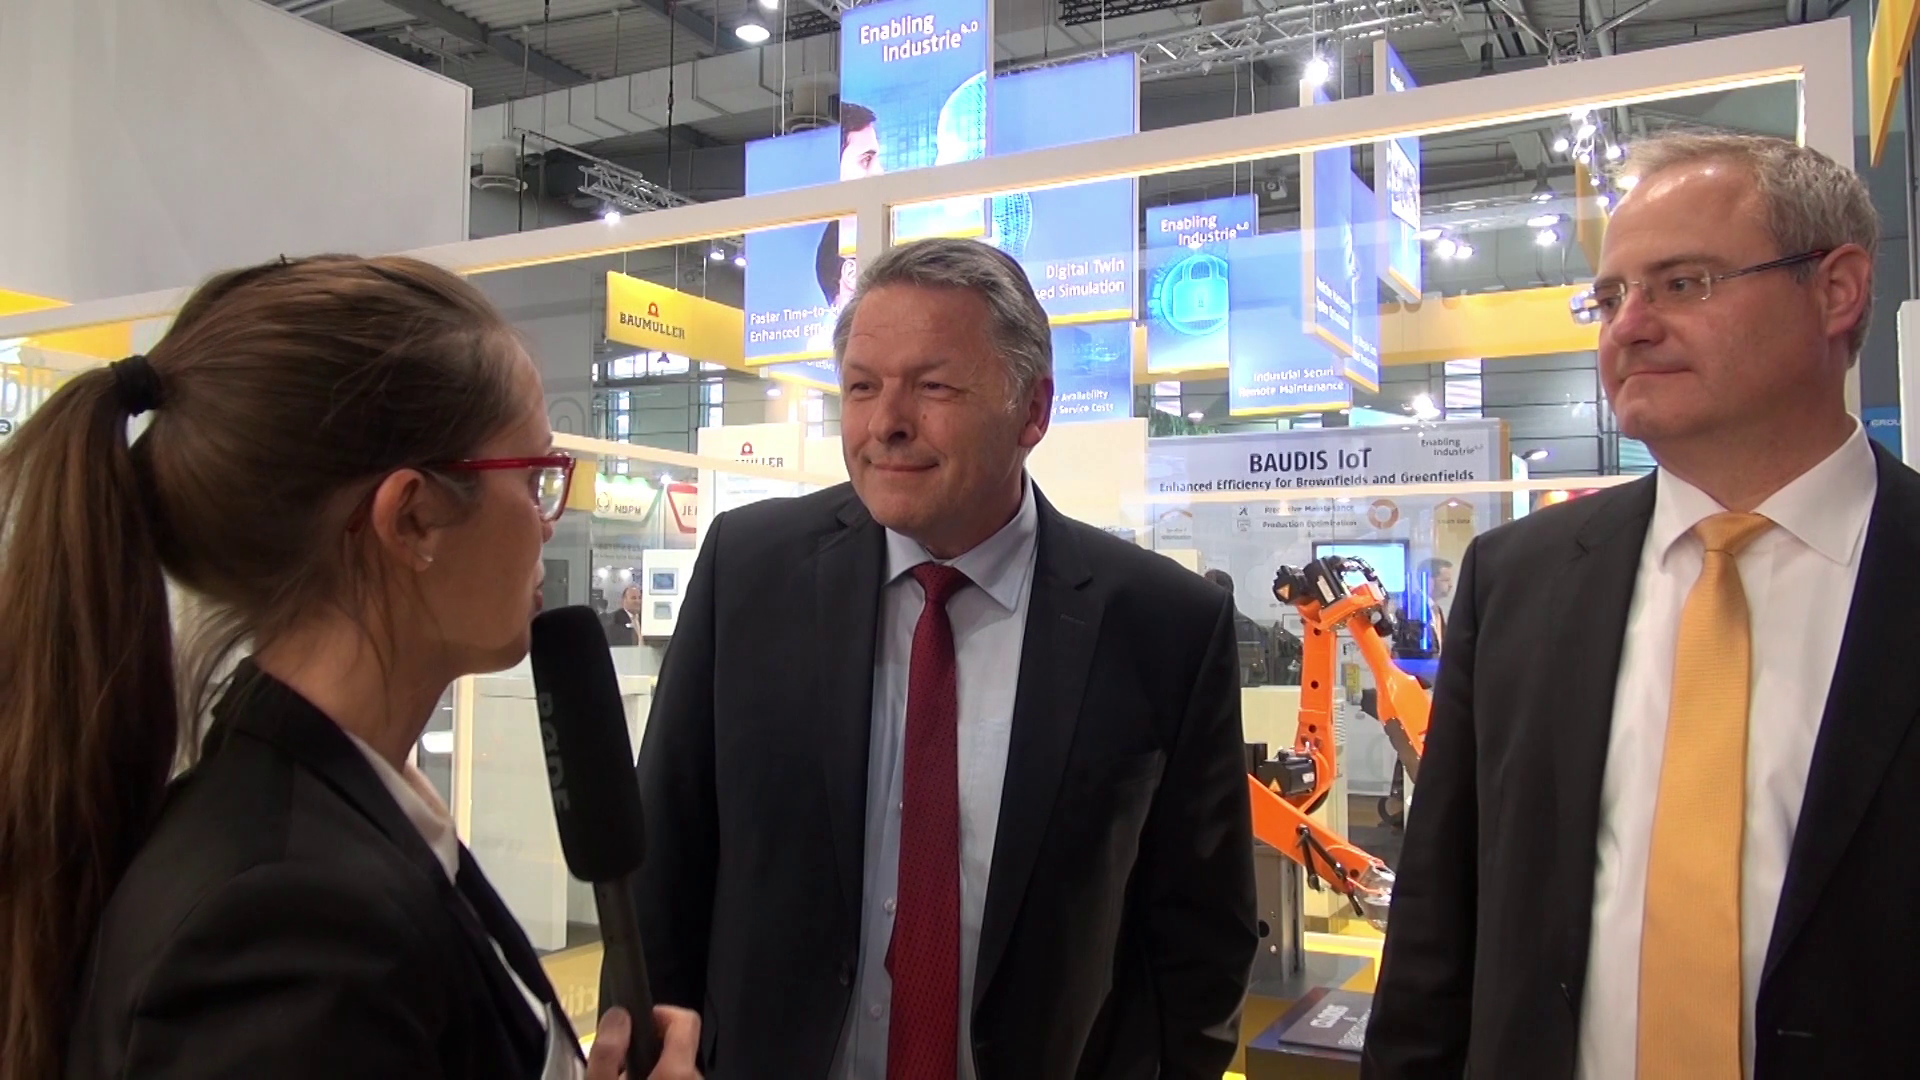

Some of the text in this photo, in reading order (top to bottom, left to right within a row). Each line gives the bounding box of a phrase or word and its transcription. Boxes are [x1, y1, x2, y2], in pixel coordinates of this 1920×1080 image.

[859, 14, 934, 45] Enabling
[1160, 214, 1217, 232] Enabling
[1045, 256, 1125, 280] Digital Twin
[1058, 278, 1125, 299] Simulation
[750, 311, 781, 326] Faster
[750, 325, 800, 343] Enhanced
[1060, 389, 1109, 402] Availability
[1279, 380, 1344, 394] Maintenance
[1059, 404, 1090, 415] Service
[1091, 402, 1115, 413] Costs
[1420, 438, 1461, 450] Enabling
[1249, 447, 1372, 474] BAUDIS IoT
[1159, 469, 1474, 493] Enhanced Efficiency for Brownfields and Greenfields
[1262, 519, 1305, 529] Production
